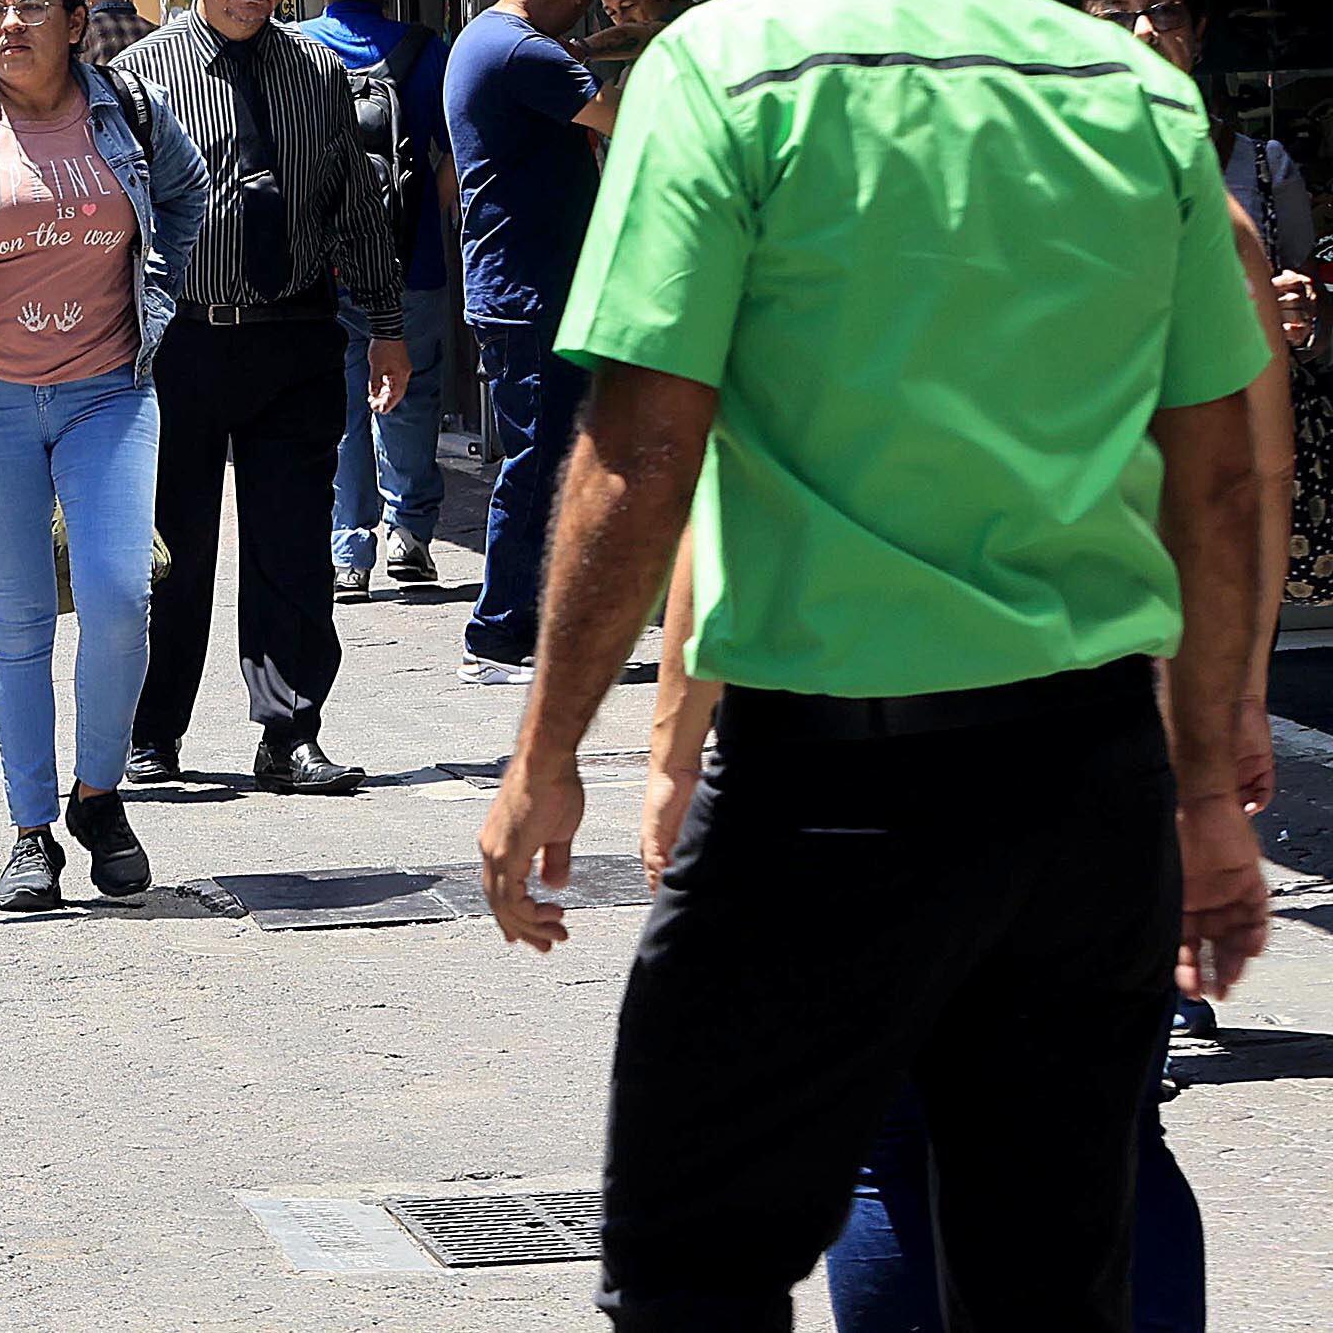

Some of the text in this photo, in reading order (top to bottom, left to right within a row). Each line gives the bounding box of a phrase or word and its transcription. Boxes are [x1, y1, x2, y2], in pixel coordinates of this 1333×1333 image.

[56, 203, 76, 220] is
[26, 221, 75, 248] the
[83, 229, 126, 254] way
